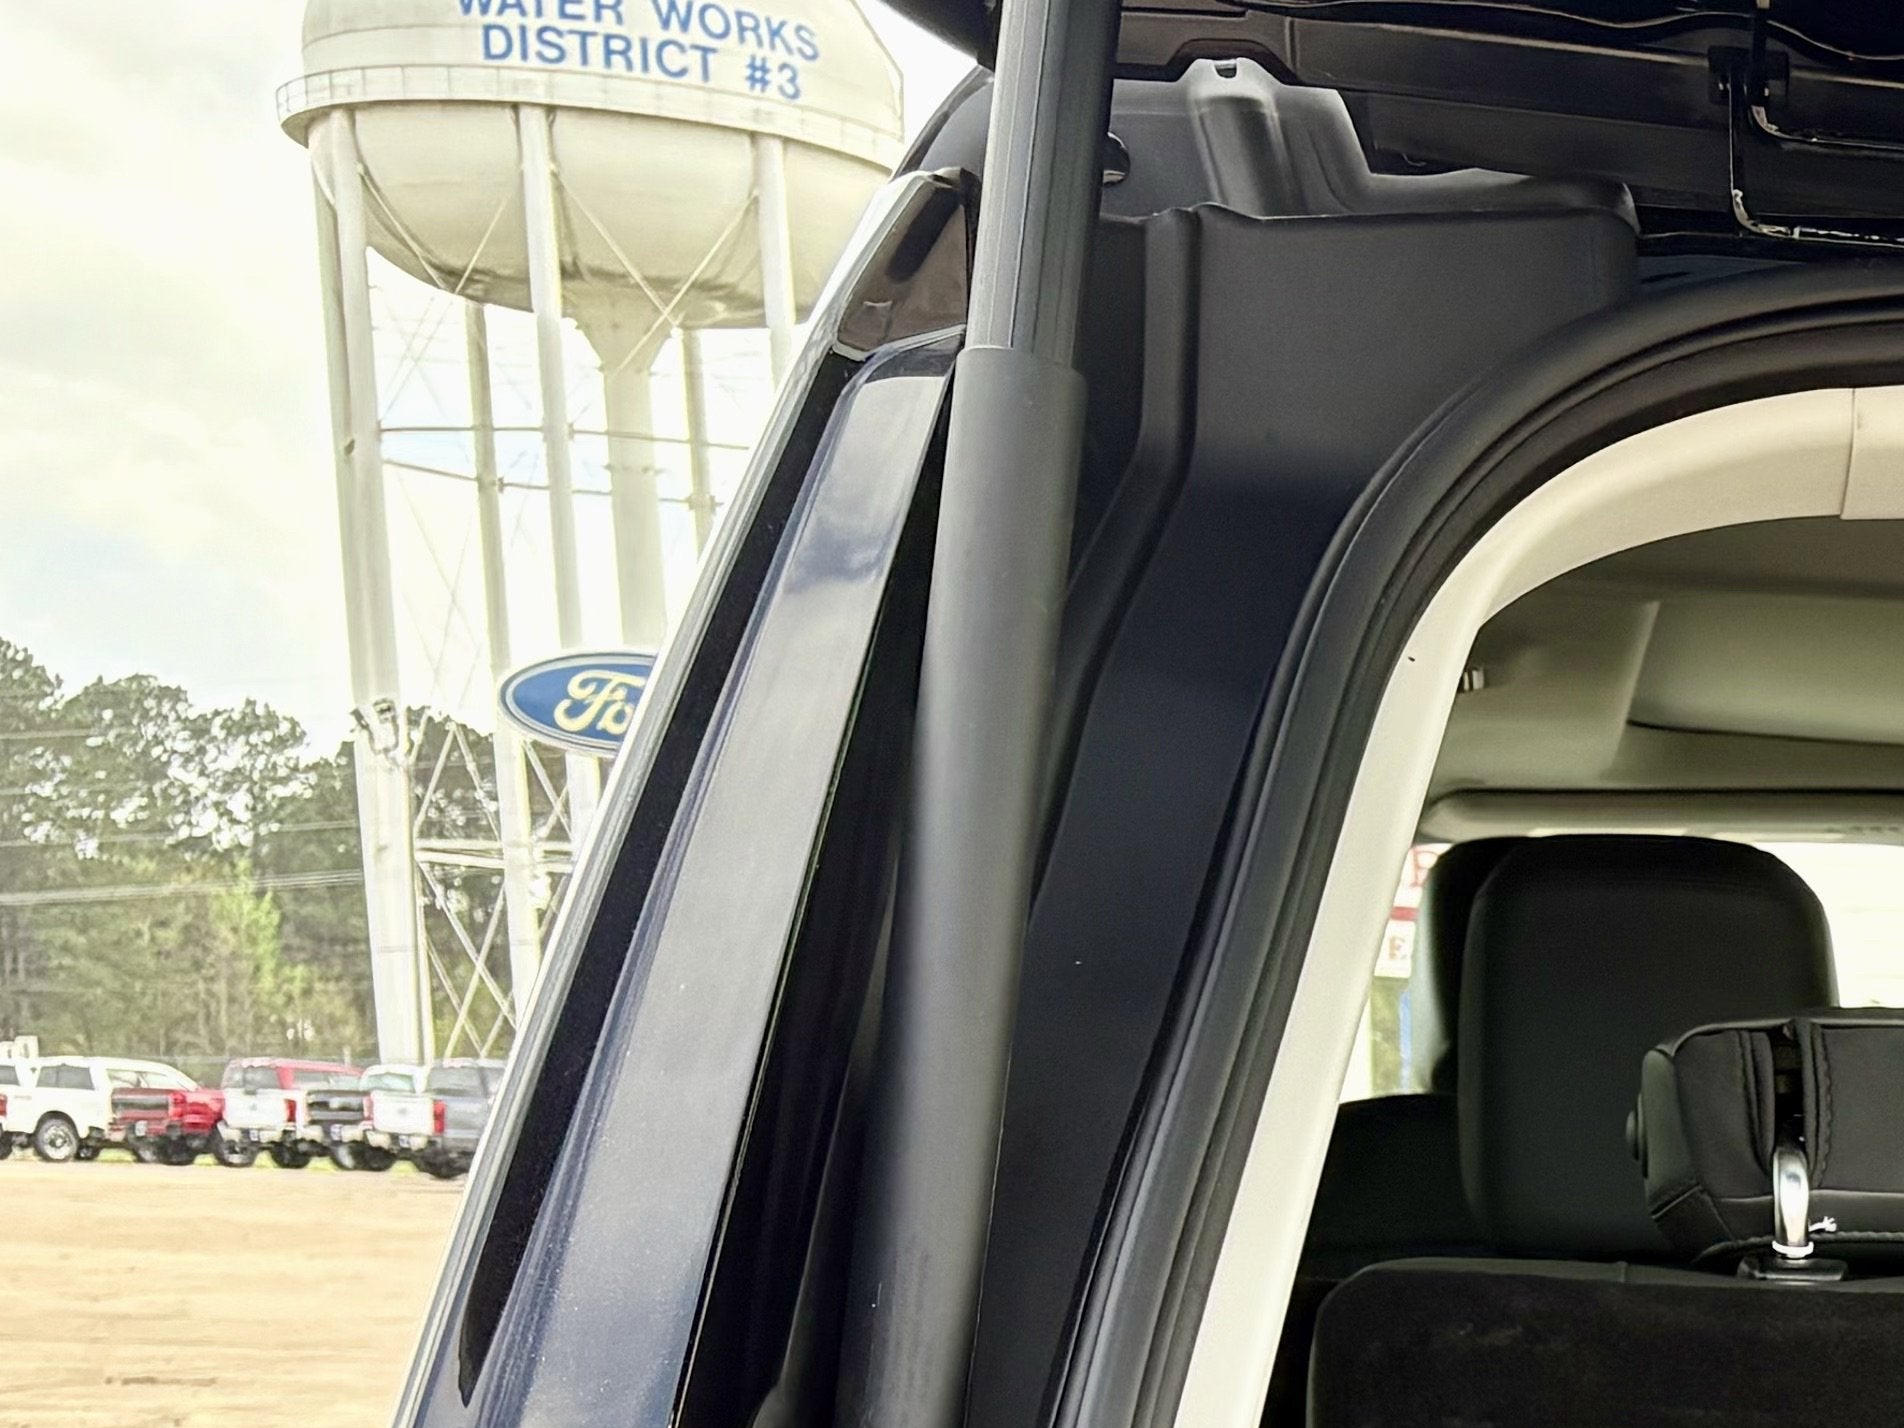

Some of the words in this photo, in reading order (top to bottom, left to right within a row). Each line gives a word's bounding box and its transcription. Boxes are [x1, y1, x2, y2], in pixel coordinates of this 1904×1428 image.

[482, 23, 718, 82] DISTRICT
[745, 54, 801, 100] #3
[651, 0, 819, 61] WORKS
[553, 669, 648, 734] Fo
